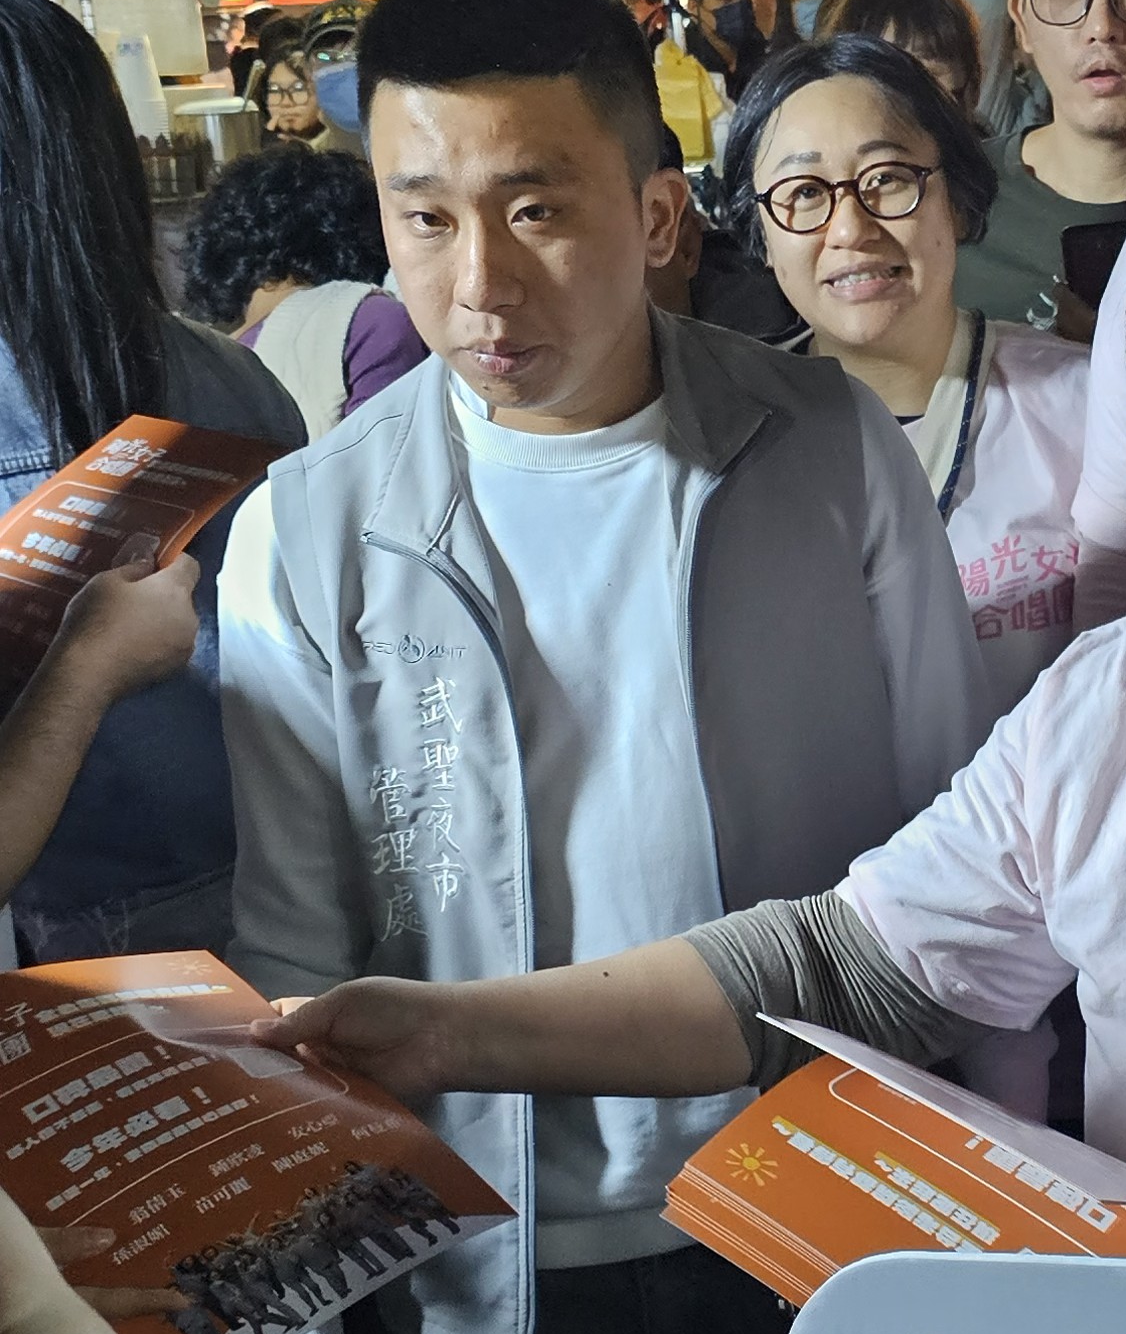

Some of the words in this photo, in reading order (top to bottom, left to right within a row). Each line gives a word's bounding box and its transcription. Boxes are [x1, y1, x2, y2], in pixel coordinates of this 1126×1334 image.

[370, 767, 427, 942] 管理處
[419, 677, 464, 912] 武聖夜市
